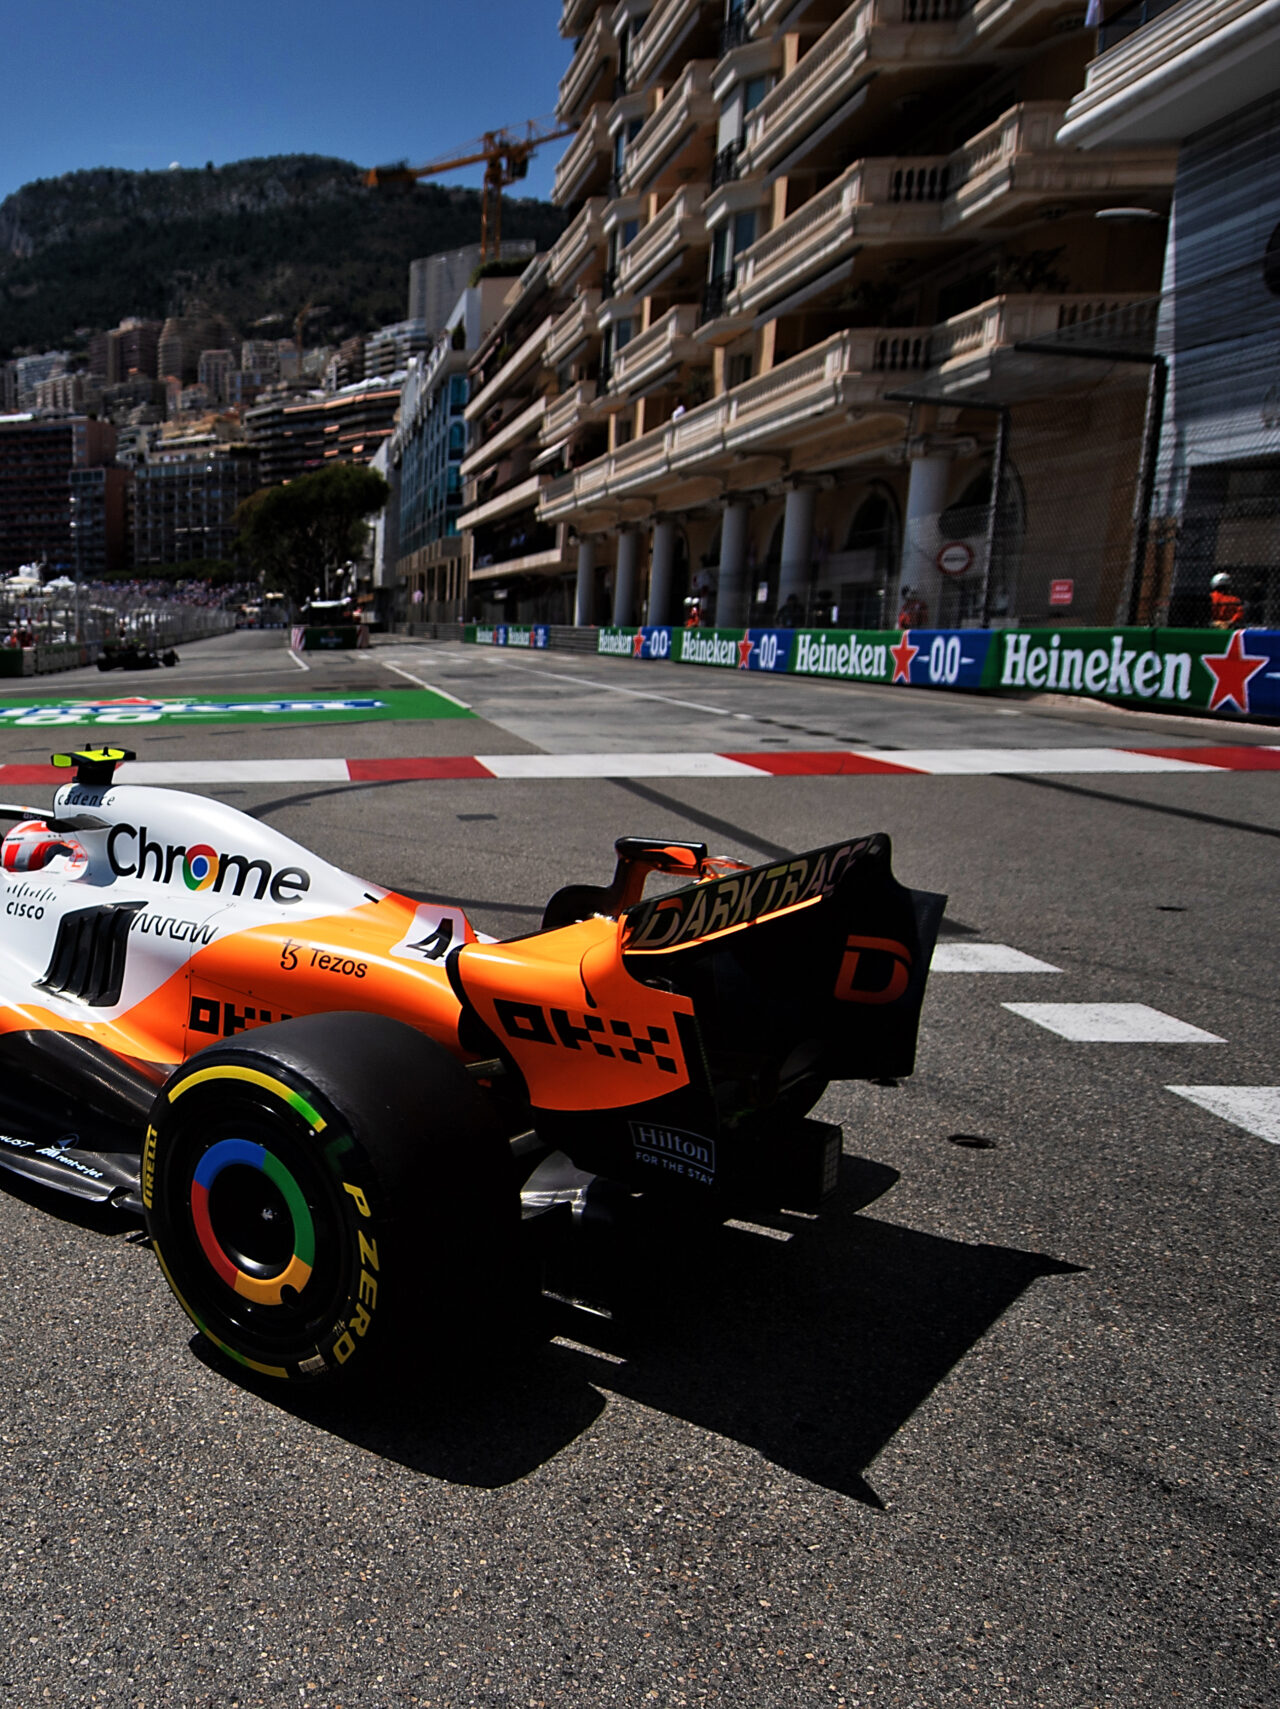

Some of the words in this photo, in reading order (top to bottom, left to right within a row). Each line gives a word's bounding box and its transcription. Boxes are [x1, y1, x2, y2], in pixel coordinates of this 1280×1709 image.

[598, 628, 632, 654] Heineken
[681, 630, 736, 664] Heineken
[795, 633, 887, 677] Heineken
[929, 635, 961, 684] 0.0
[1001, 633, 1192, 700] Heineken
[107, 822, 311, 905] Chrome
[6, 902, 45, 920] CISCO
[131, 913, 219, 945] ARROW
[406, 917, 453, 960] 4
[308, 947, 368, 978] Tezos
[493, 997, 678, 1074] OKX
[639, 1126, 708, 1163] Hilton
[636, 1151, 658, 1165] FOR
[662, 1159, 684, 1174] THE
[688, 1168, 714, 1185] STAY
[342, 1181, 372, 1219] P
[332, 1229, 381, 1366] ZERO
